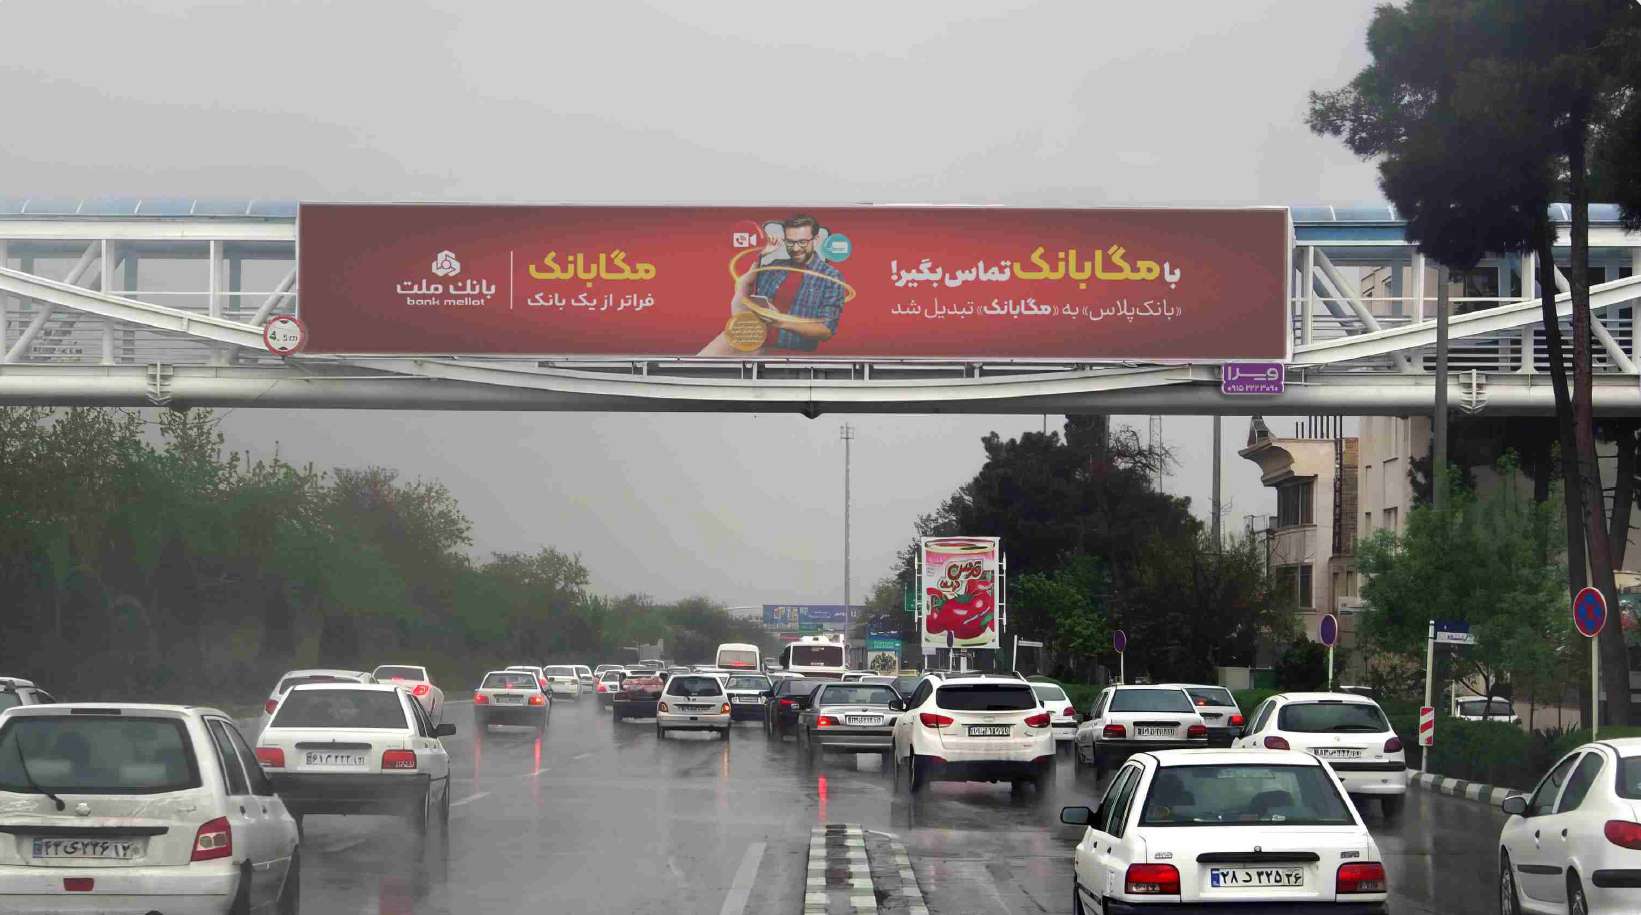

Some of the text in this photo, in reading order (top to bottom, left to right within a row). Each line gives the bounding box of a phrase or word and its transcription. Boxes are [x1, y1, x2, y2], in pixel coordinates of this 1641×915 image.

[528, 249, 657, 288] مگابانک
[890, 244, 1181, 290] با مگابانک تماس بگیر!
[396, 278, 443, 294] ملت
[406, 297, 440, 306] bank
[527, 292, 655, 311] فراتر از یک بانک
[891, 299, 921, 315] شد
[924, 297, 974, 319] تبدیل
[1062, 303, 1079, 319] به
